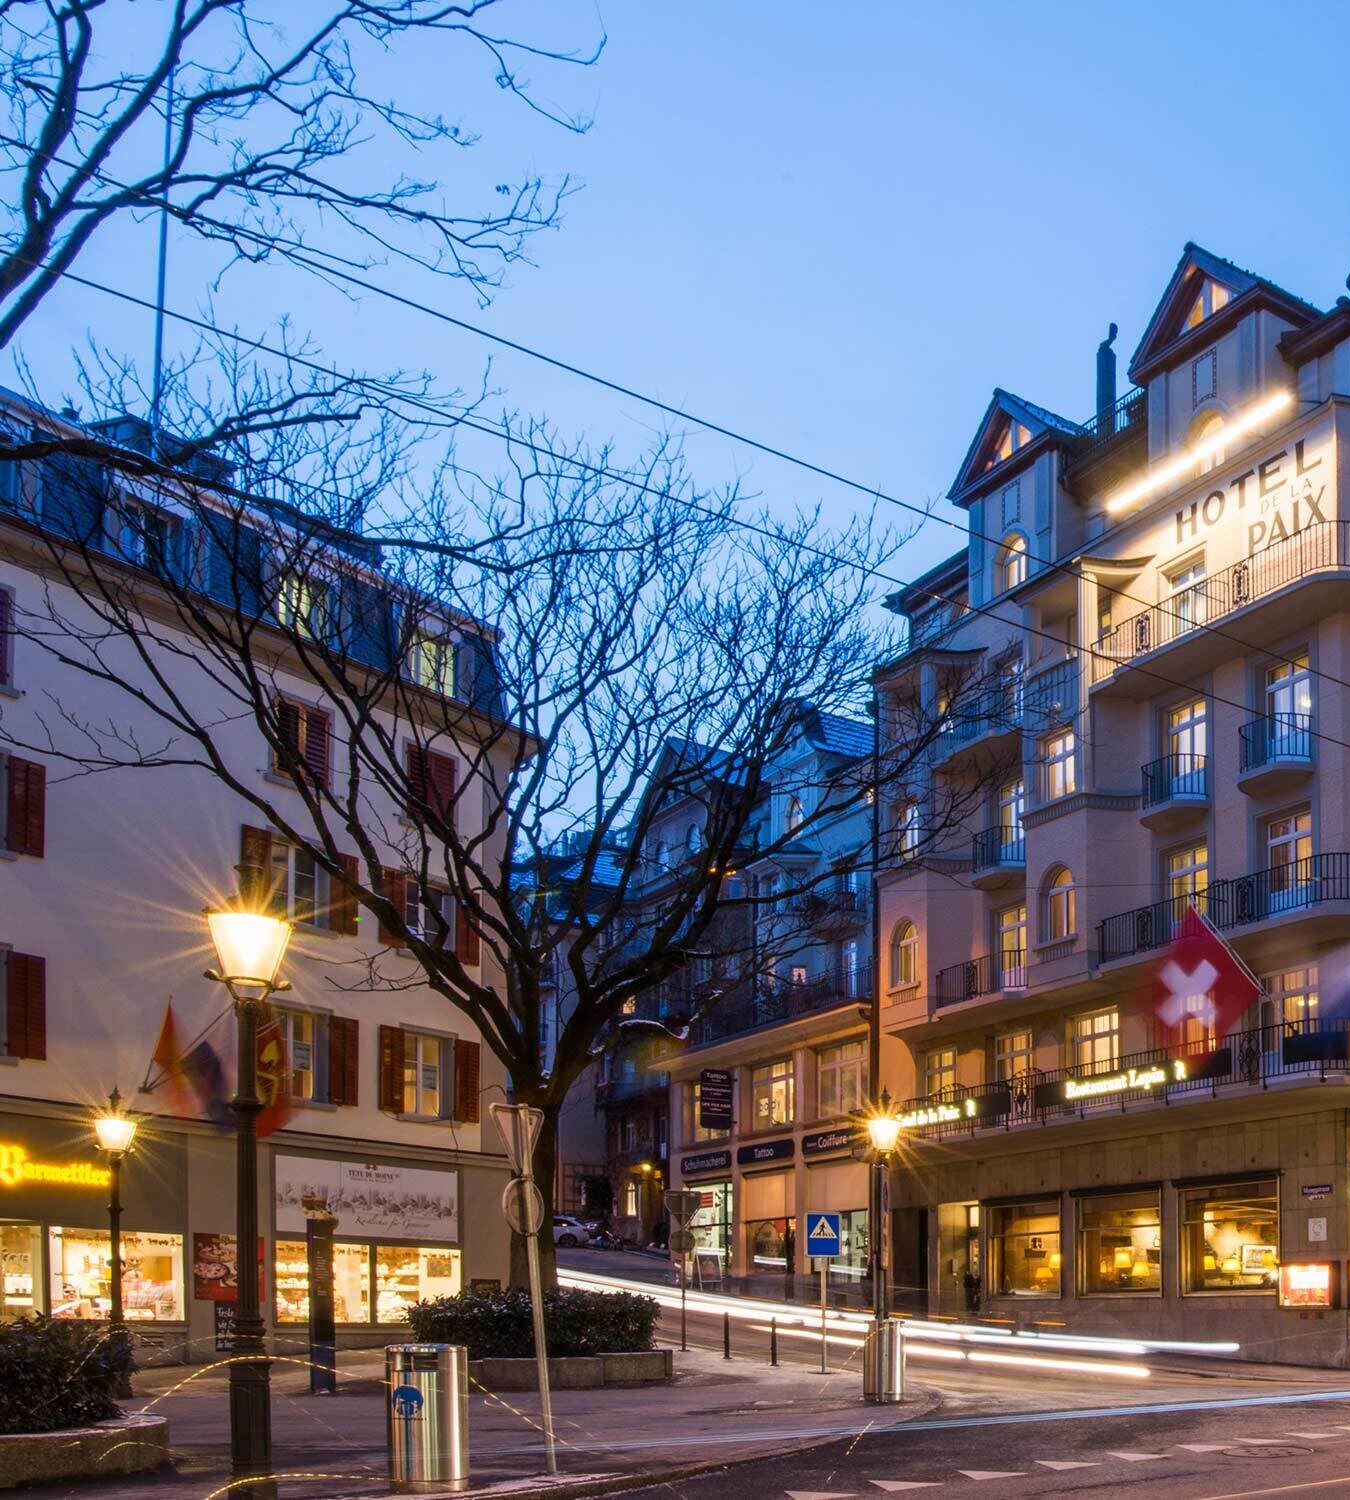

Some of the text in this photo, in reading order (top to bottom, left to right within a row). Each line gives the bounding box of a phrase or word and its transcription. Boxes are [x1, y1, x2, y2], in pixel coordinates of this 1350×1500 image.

[1175, 438, 1322, 544] HOTEL
[1260, 477, 1312, 514] DE LA
[1248, 485, 1327, 553] PAIX
[1065, 1067, 1165, 1099] Restaurant Lapin
[754, 1146, 775, 1160] Tattoo
[817, 1133, 849, 1149] Coiffure
